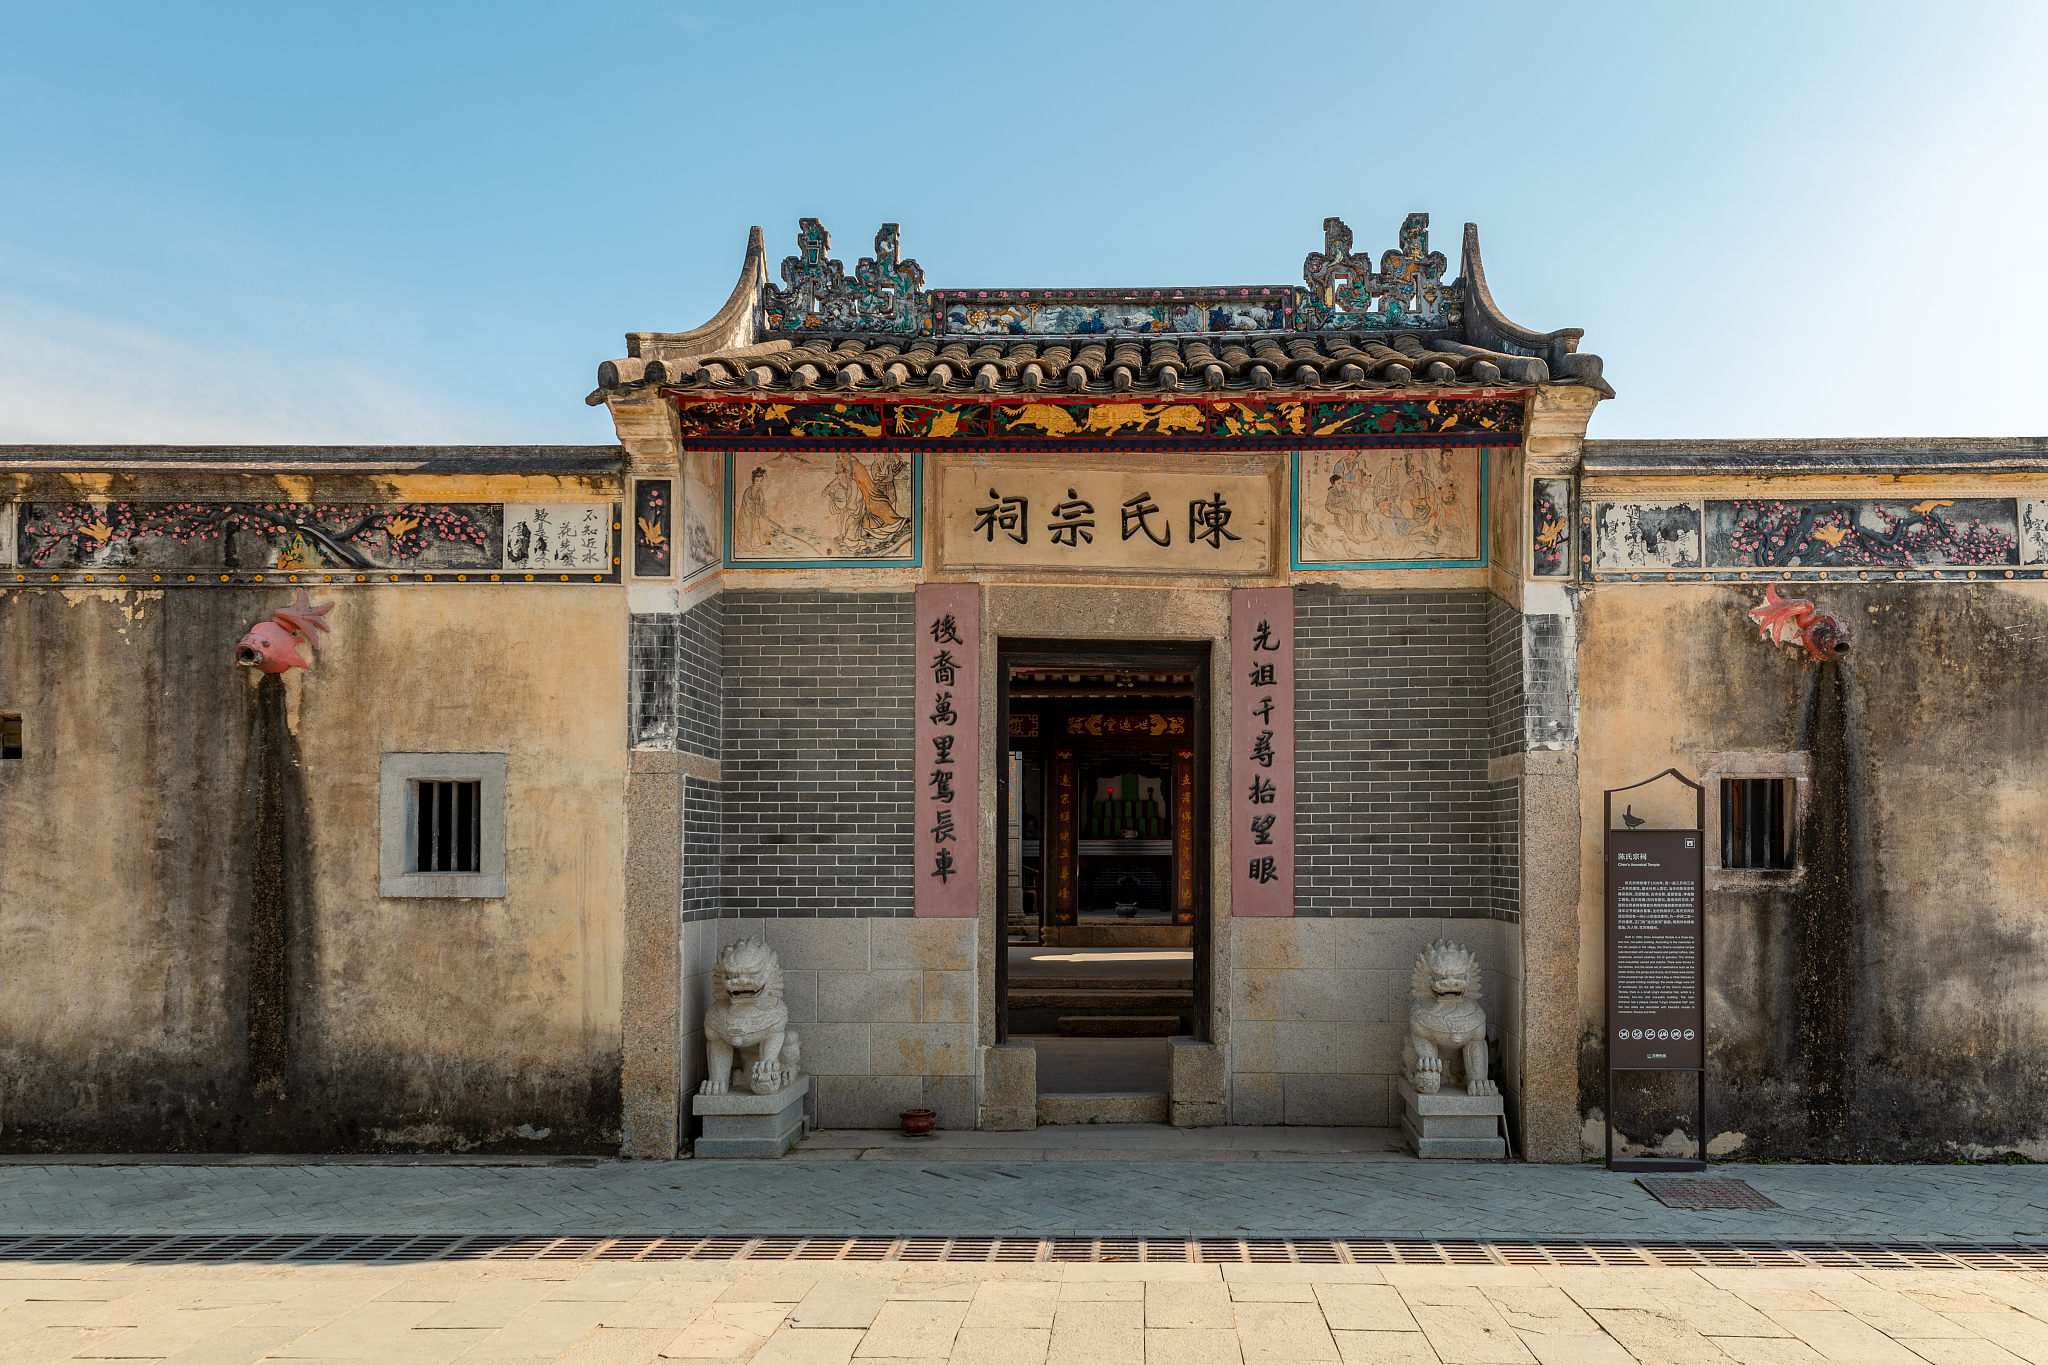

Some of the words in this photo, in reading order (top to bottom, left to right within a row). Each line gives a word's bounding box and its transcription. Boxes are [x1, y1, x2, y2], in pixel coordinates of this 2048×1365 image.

[973, 487, 1242, 550] 陳氏宗祠
[928, 611, 963, 885] 後裔萬里駕長車
[1248, 618, 1280, 885] 先祖千尋抬望眼
[1617, 852, 1647, 861] 陈氏宗祠
